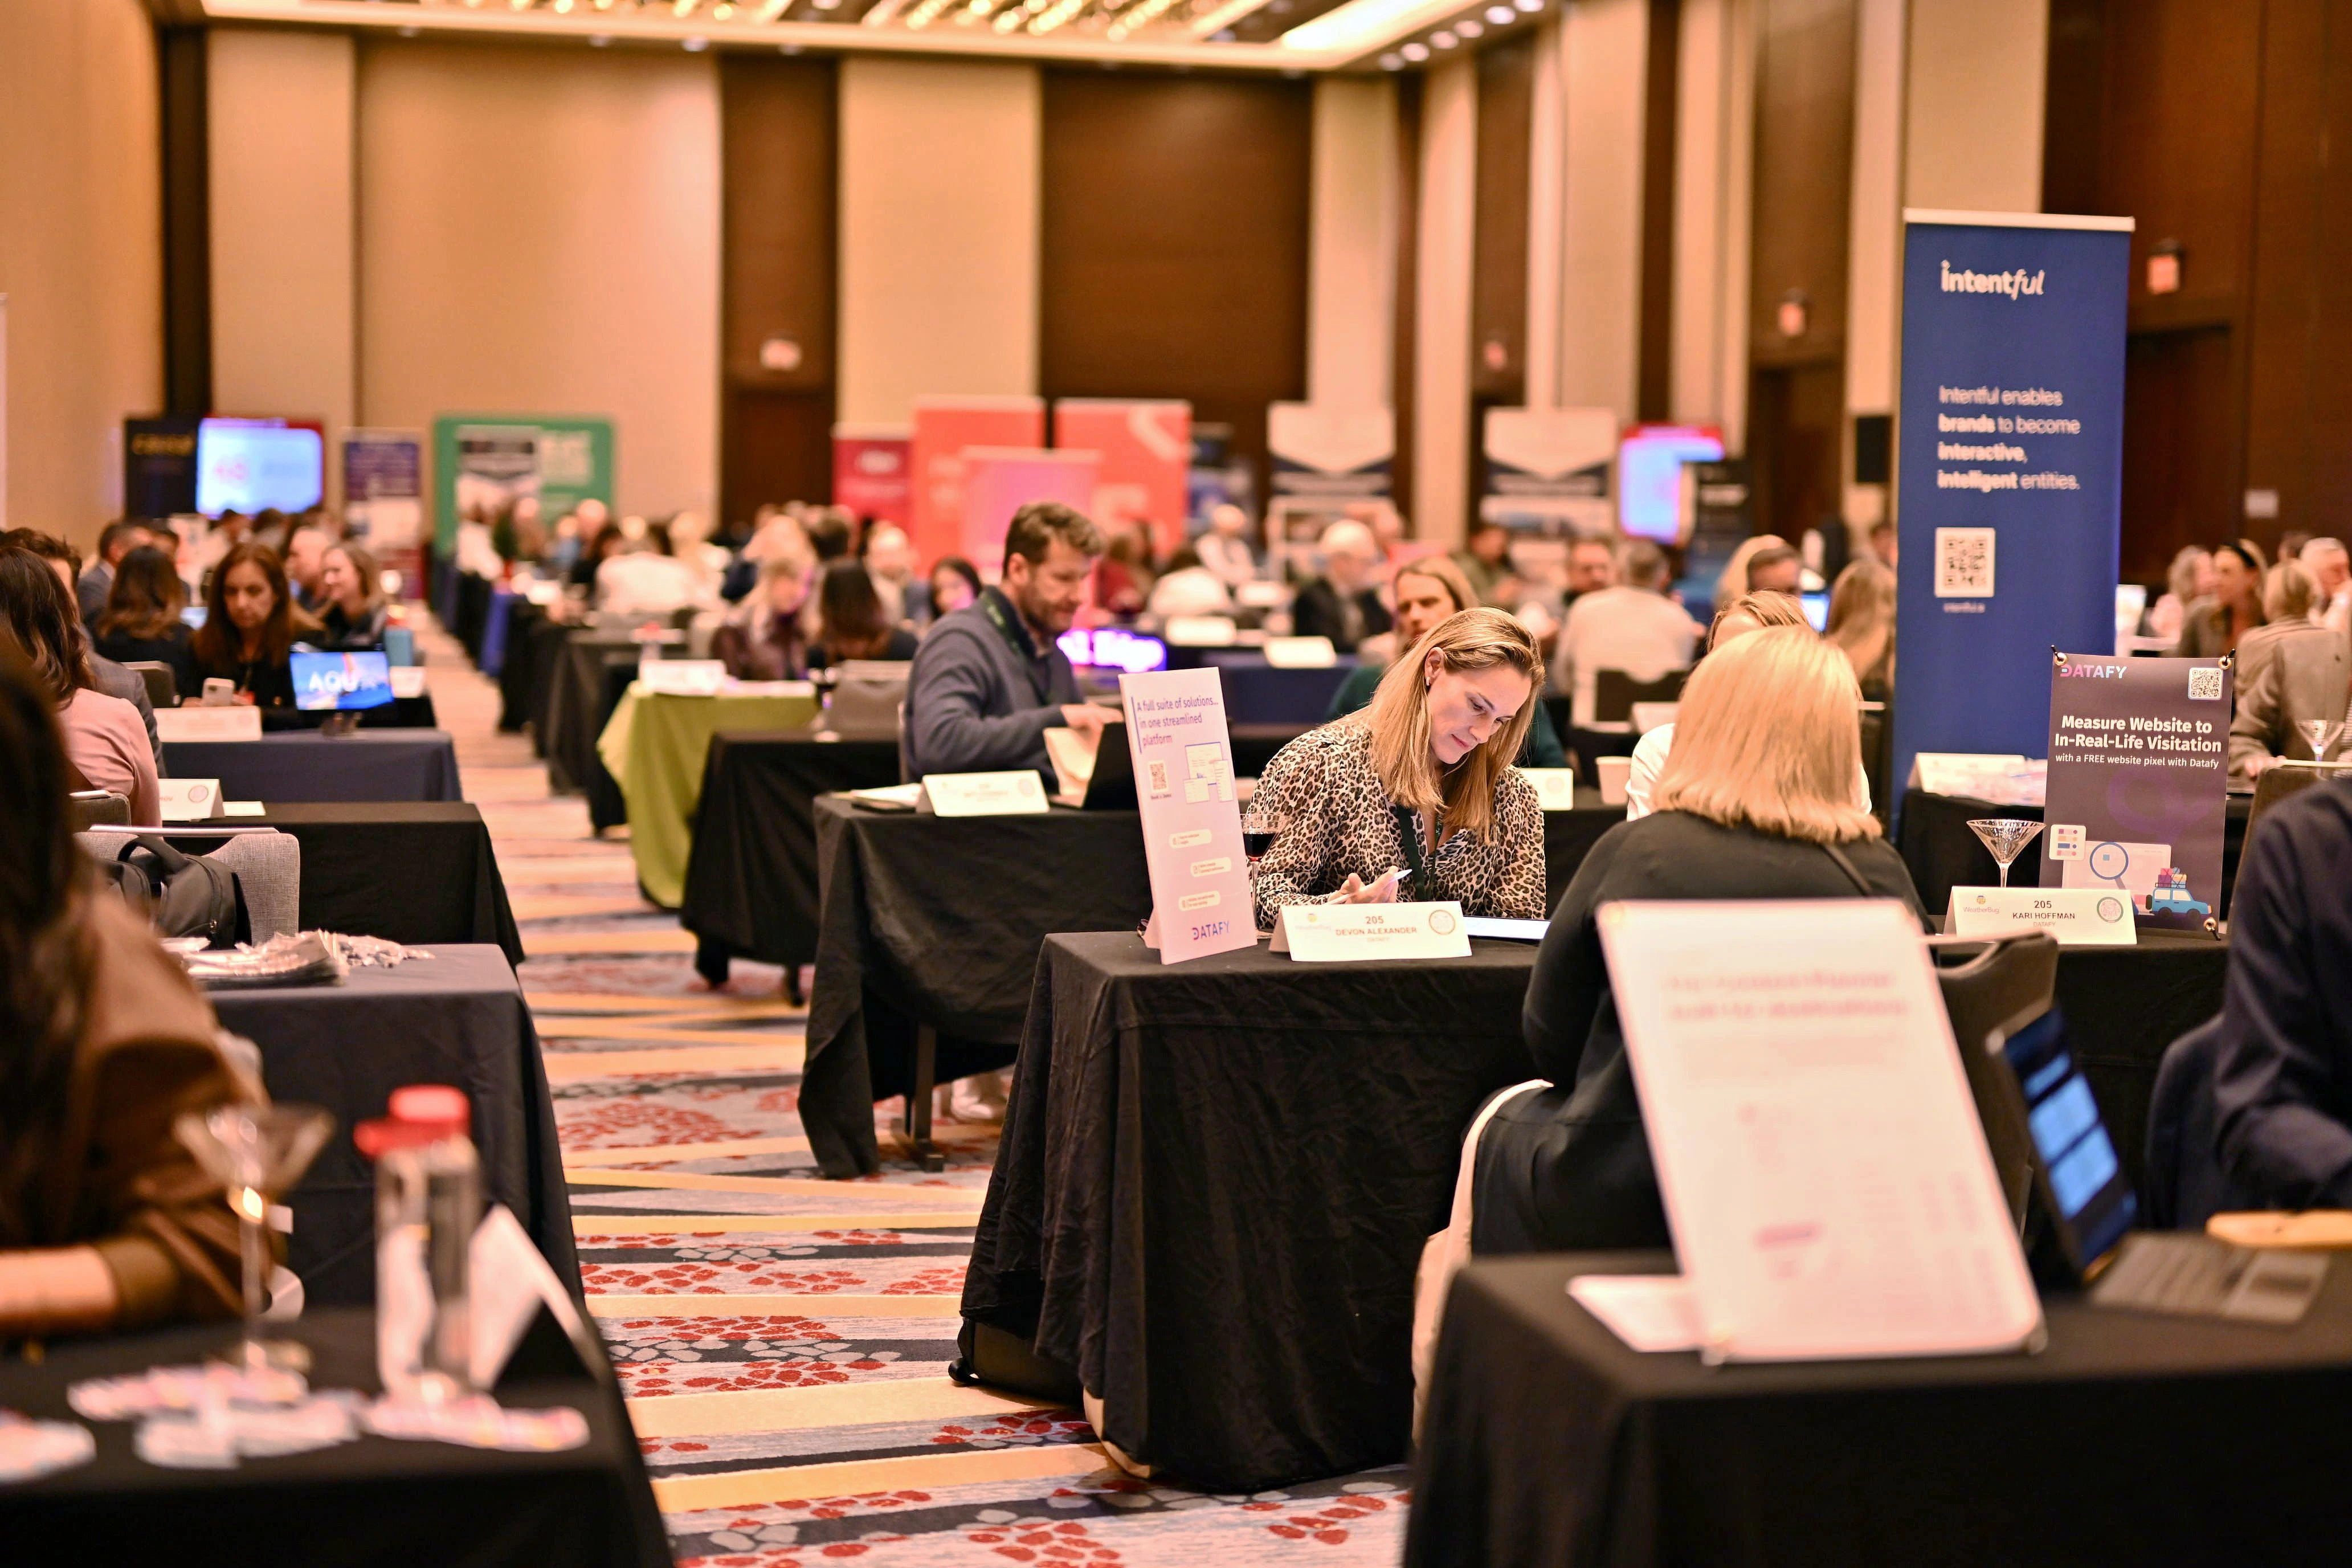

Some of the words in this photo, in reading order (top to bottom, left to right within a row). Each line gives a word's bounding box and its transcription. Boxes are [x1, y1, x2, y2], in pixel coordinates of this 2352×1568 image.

[1941, 260, 2045, 300] intentful
[1939, 385, 1999, 406] Intentful
[2001, 386, 2063, 406] enables
[1938, 414, 1996, 434] brands
[1998, 416, 2014, 433] to
[2015, 415, 2081, 435] become
[1937, 442, 2028, 464] interactive,
[1937, 469, 2019, 493] intelligent
[2020, 471, 2080, 491] entities.
[2060, 664, 2128, 679] DATAFY
[1157, 698, 1174, 710] suite
[1175, 697, 1182, 709] of
[1148, 718, 1161, 729] one
[1162, 712, 1202, 726] streamlined
[2061, 715, 2126, 730] Measure
[2129, 717, 2192, 733] Website
[2195, 720, 2212, 734] to
[1142, 734, 1173, 749] platform
[2055, 733, 2143, 750] In-Real-Life
[2146, 735, 2222, 752] Visitation
[2055, 753, 2073, 762] with
[2084, 754, 2105, 763] FREE
[2107, 755, 2142, 765] website
[2143, 756, 2166, 767] pixel
[2167, 757, 2187, 767] with
[2189, 758, 2220, 770] Datafy
[1963, 906, 2000, 914] WeatherBug
[2034, 900, 2052, 909] 205
[1365, 916, 1385, 924] 205
[1191, 920, 1231, 941] DATAFY
[1367, 926, 1418, 935] ALEXANDER
